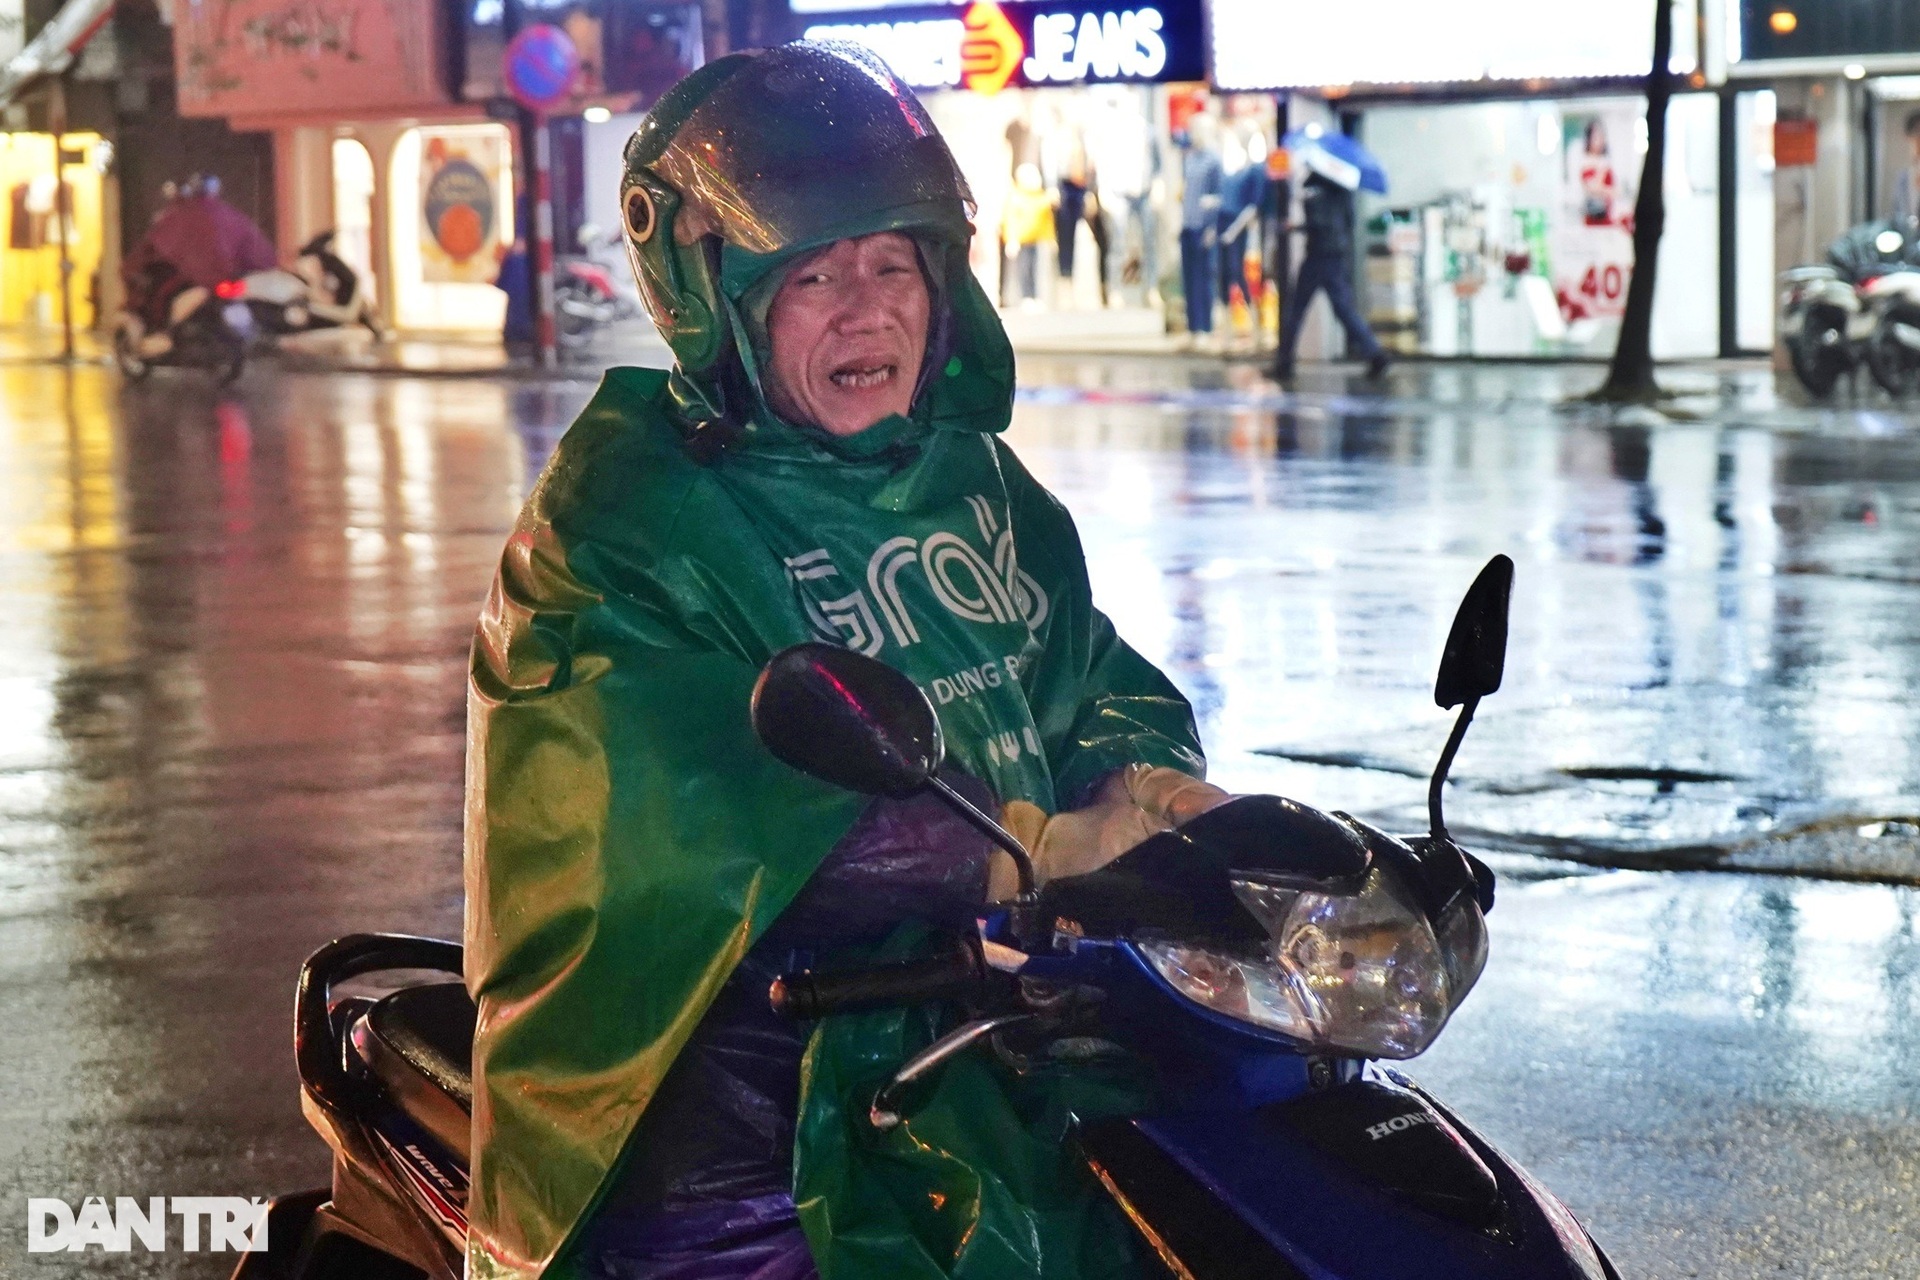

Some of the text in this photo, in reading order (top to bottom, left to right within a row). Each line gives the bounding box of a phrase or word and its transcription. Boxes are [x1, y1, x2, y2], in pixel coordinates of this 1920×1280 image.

[1023, 8, 1166, 82] JEANS
[1580, 264, 1634, 300] 40
[783, 493, 1049, 658] Grab
